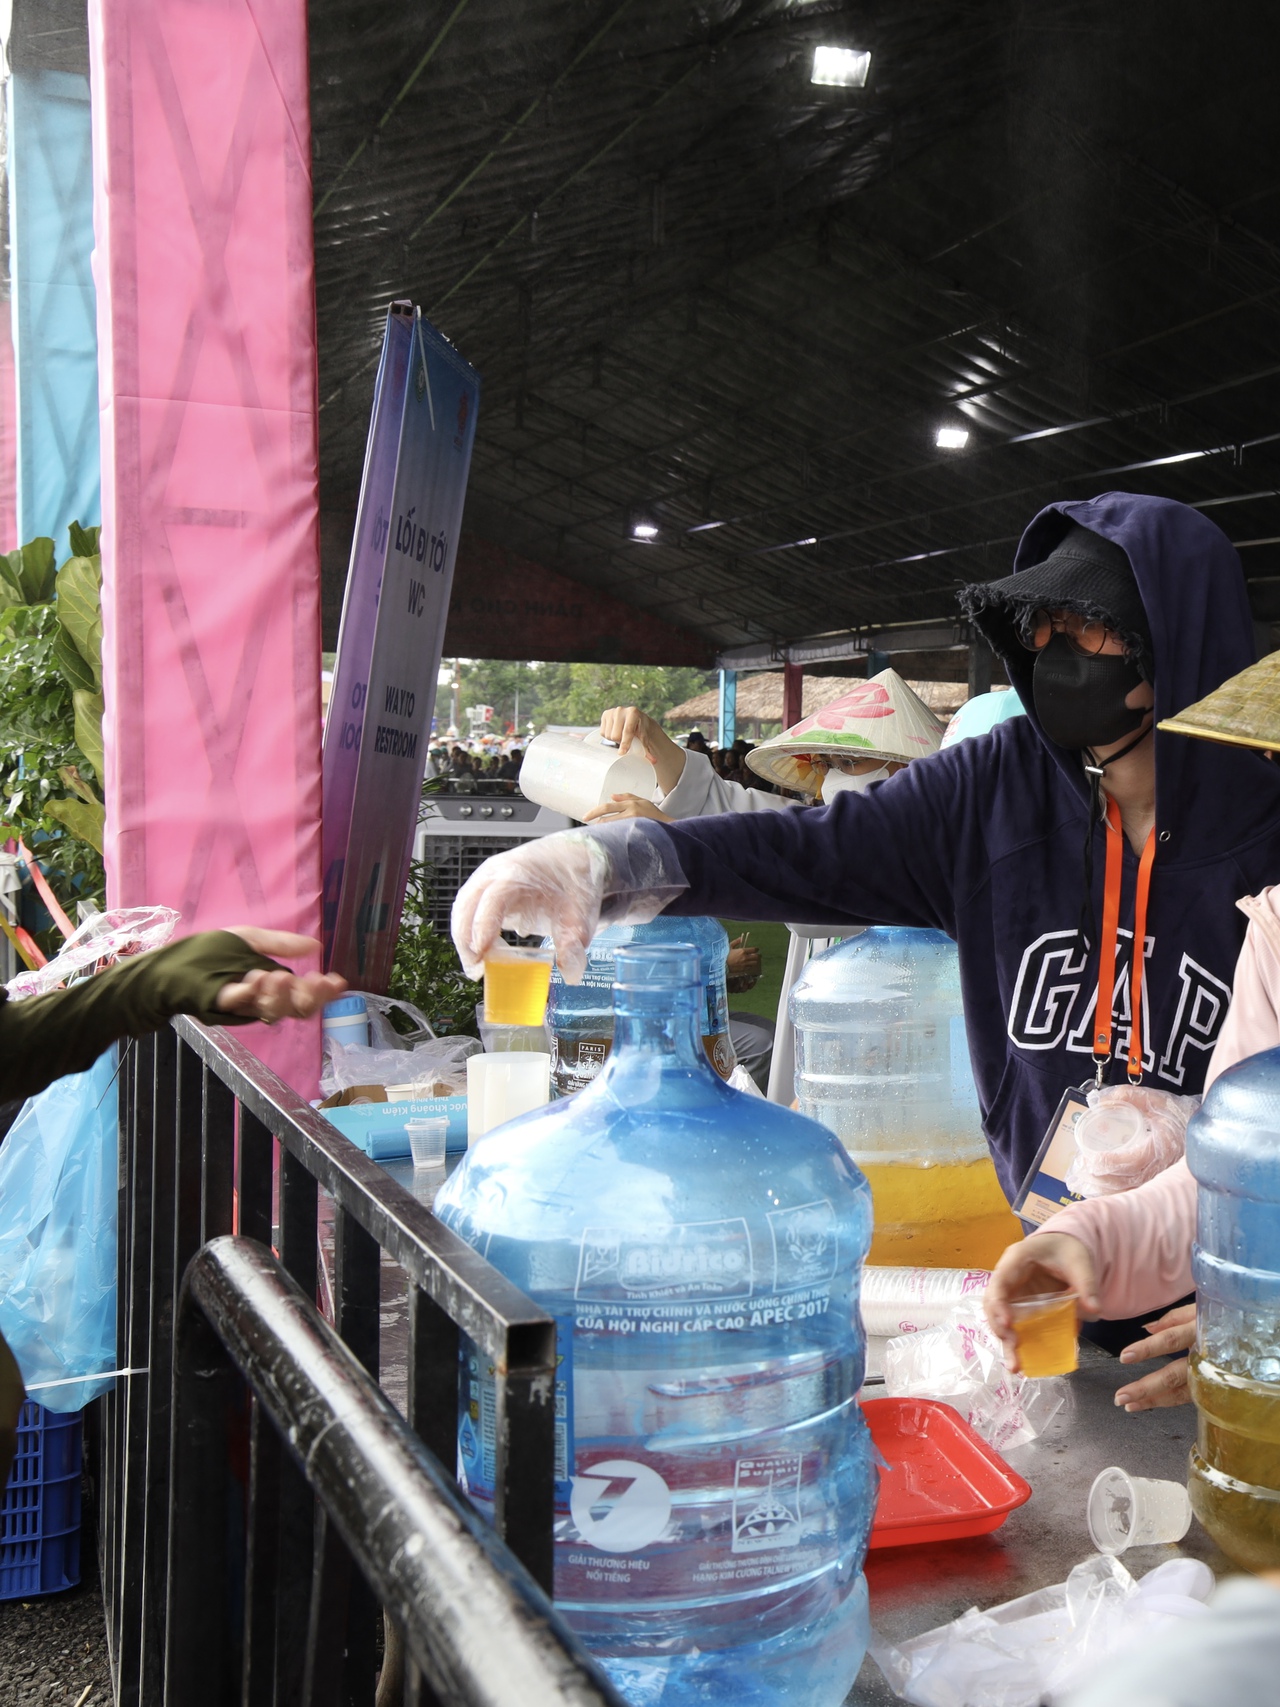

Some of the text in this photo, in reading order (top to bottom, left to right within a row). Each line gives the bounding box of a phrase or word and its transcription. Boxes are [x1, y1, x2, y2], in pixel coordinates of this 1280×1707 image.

[395, 506, 448, 574] LỐI ĐI TỚI
[408, 578, 426, 618] WC
[385, 685, 415, 719] WAY TO
[374, 726, 418, 759] RESTROOM
[1007, 929, 1233, 1087] GAP
[628, 1245, 744, 1275] Bidrico
[575, 1315, 605, 1330] CỦA
[608, 1318, 636, 1335] HỘI
[640, 1320, 680, 1336] NGHỊ
[716, 1315, 745, 1330] CAO
[750, 1305, 794, 1327] APEC
[798, 1297, 830, 1319] 2017
